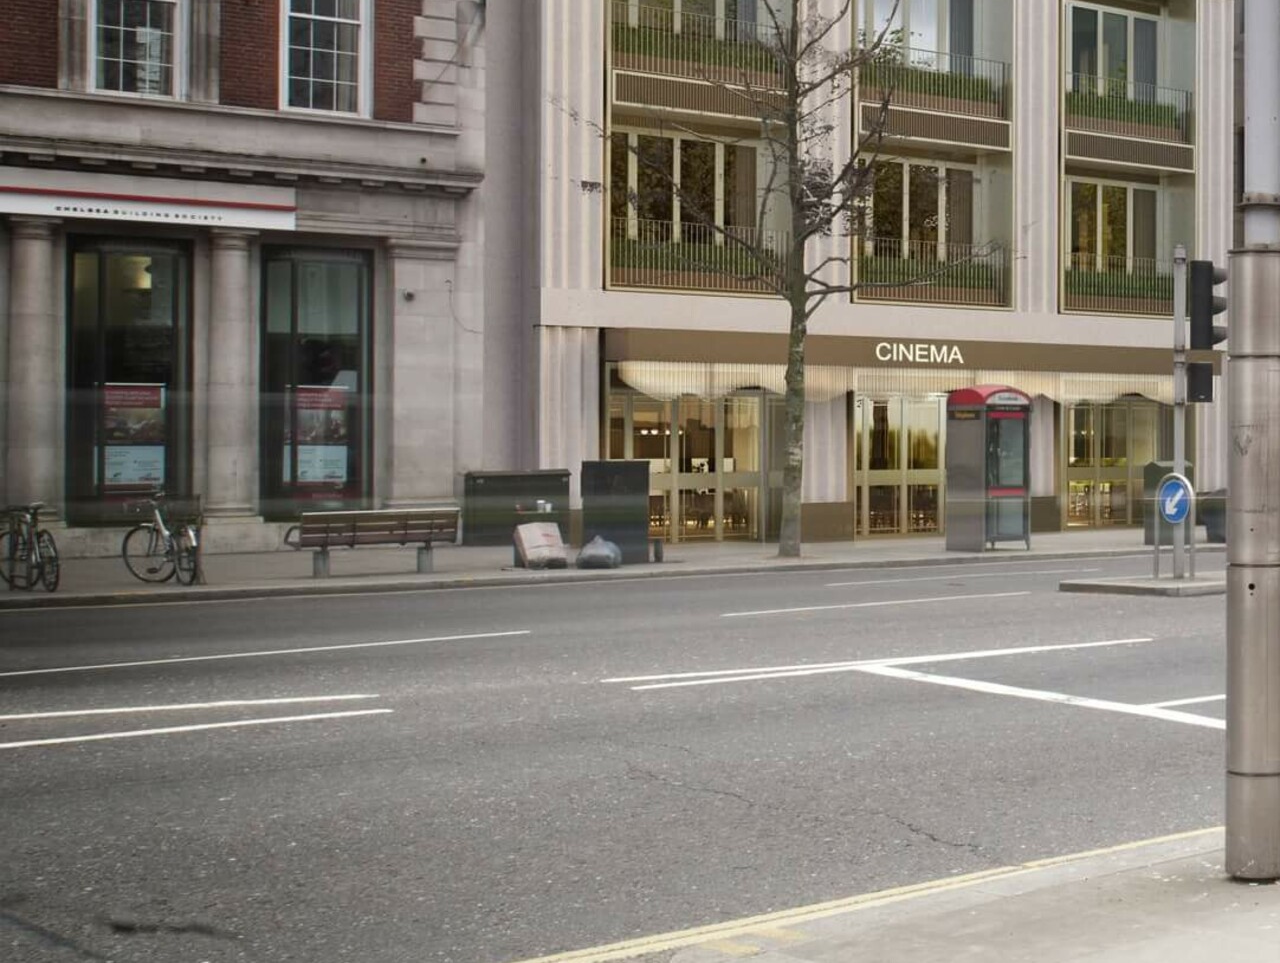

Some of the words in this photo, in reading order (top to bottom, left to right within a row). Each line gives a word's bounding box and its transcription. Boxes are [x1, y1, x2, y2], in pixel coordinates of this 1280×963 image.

[55, 206, 109, 214] CHELSEA
[113, 209, 170, 218] BUILDING
[875, 342, 964, 364] CINEMA
